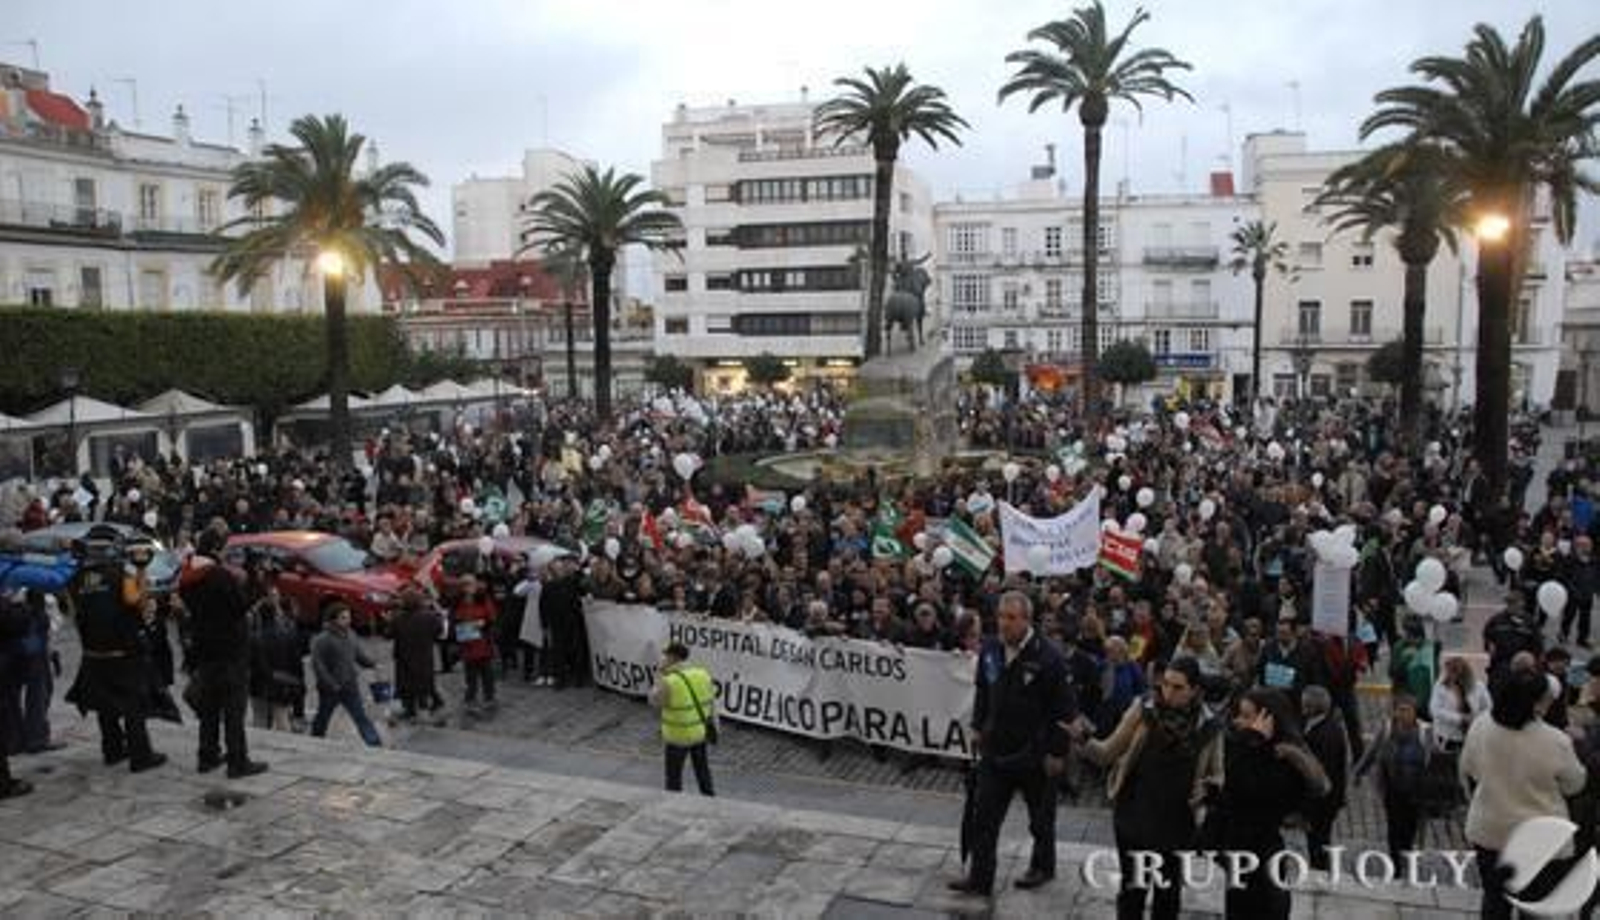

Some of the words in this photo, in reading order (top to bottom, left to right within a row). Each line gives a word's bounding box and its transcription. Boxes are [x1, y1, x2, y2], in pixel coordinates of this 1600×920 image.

[669, 623, 766, 657] HOSPITAL
[819, 646, 906, 681] CARLOS
[594, 653, 659, 691] HOSPI
[820, 700, 912, 746] PARA
[921, 715, 968, 754] LA
